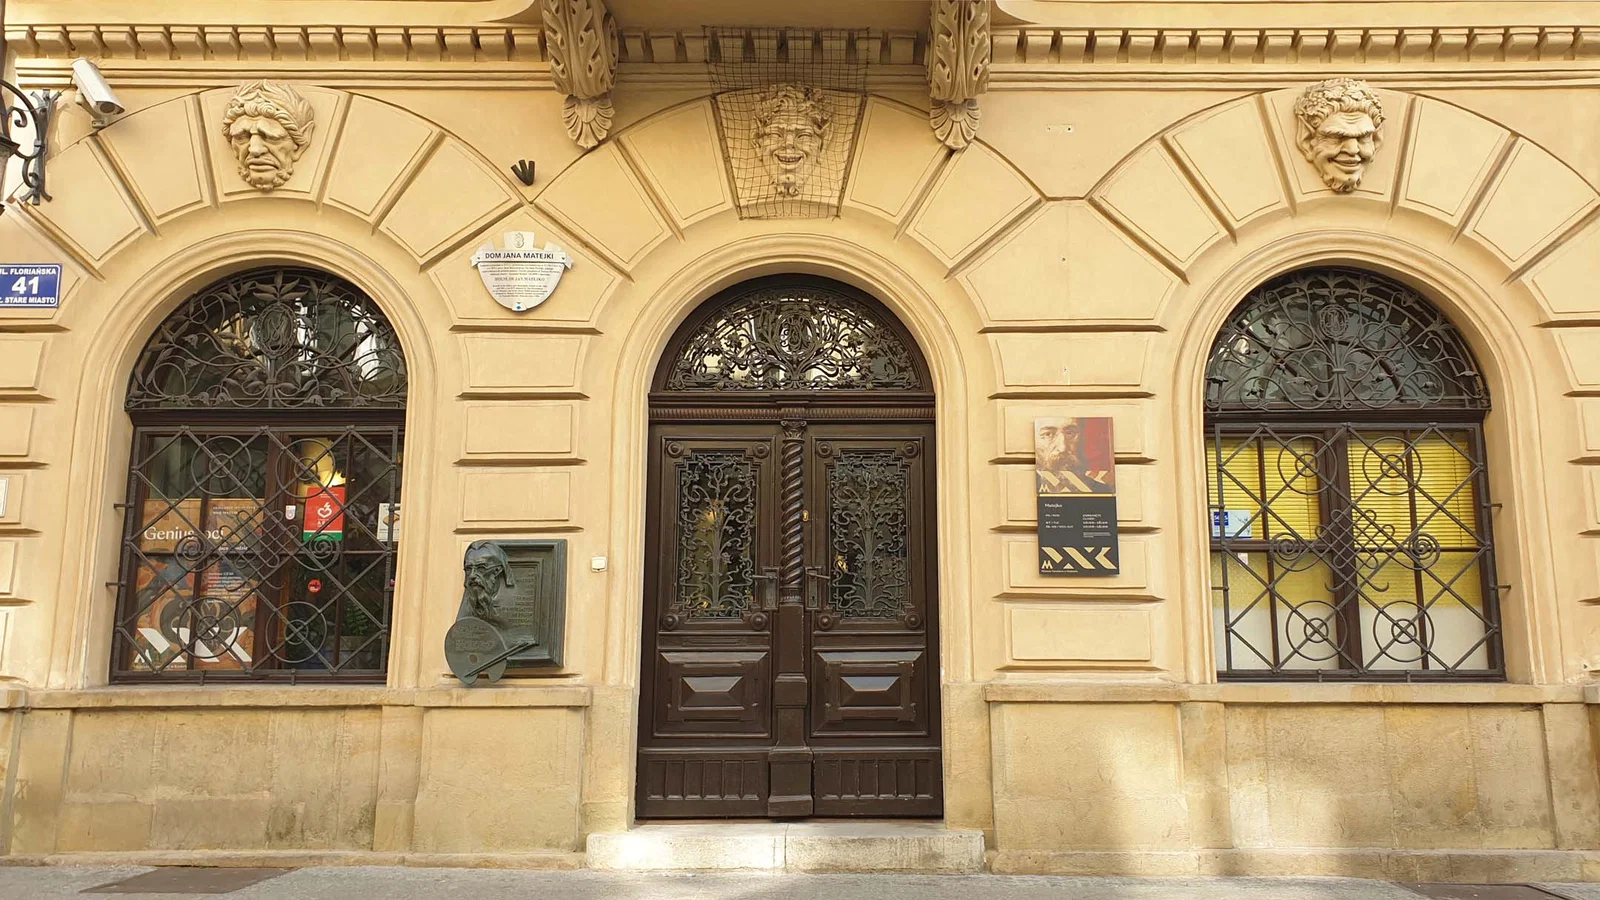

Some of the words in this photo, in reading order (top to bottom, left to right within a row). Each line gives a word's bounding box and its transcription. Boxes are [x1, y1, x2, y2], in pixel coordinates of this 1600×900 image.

[10, 267, 56, 275] FLORIAŃSKA
[11, 276, 40, 295] 41
[5, 296, 28, 304] STARE
[28, 296, 55, 304] MIASTO
[144, 526, 195, 540] Genius
[204, 528, 225, 540] oci
